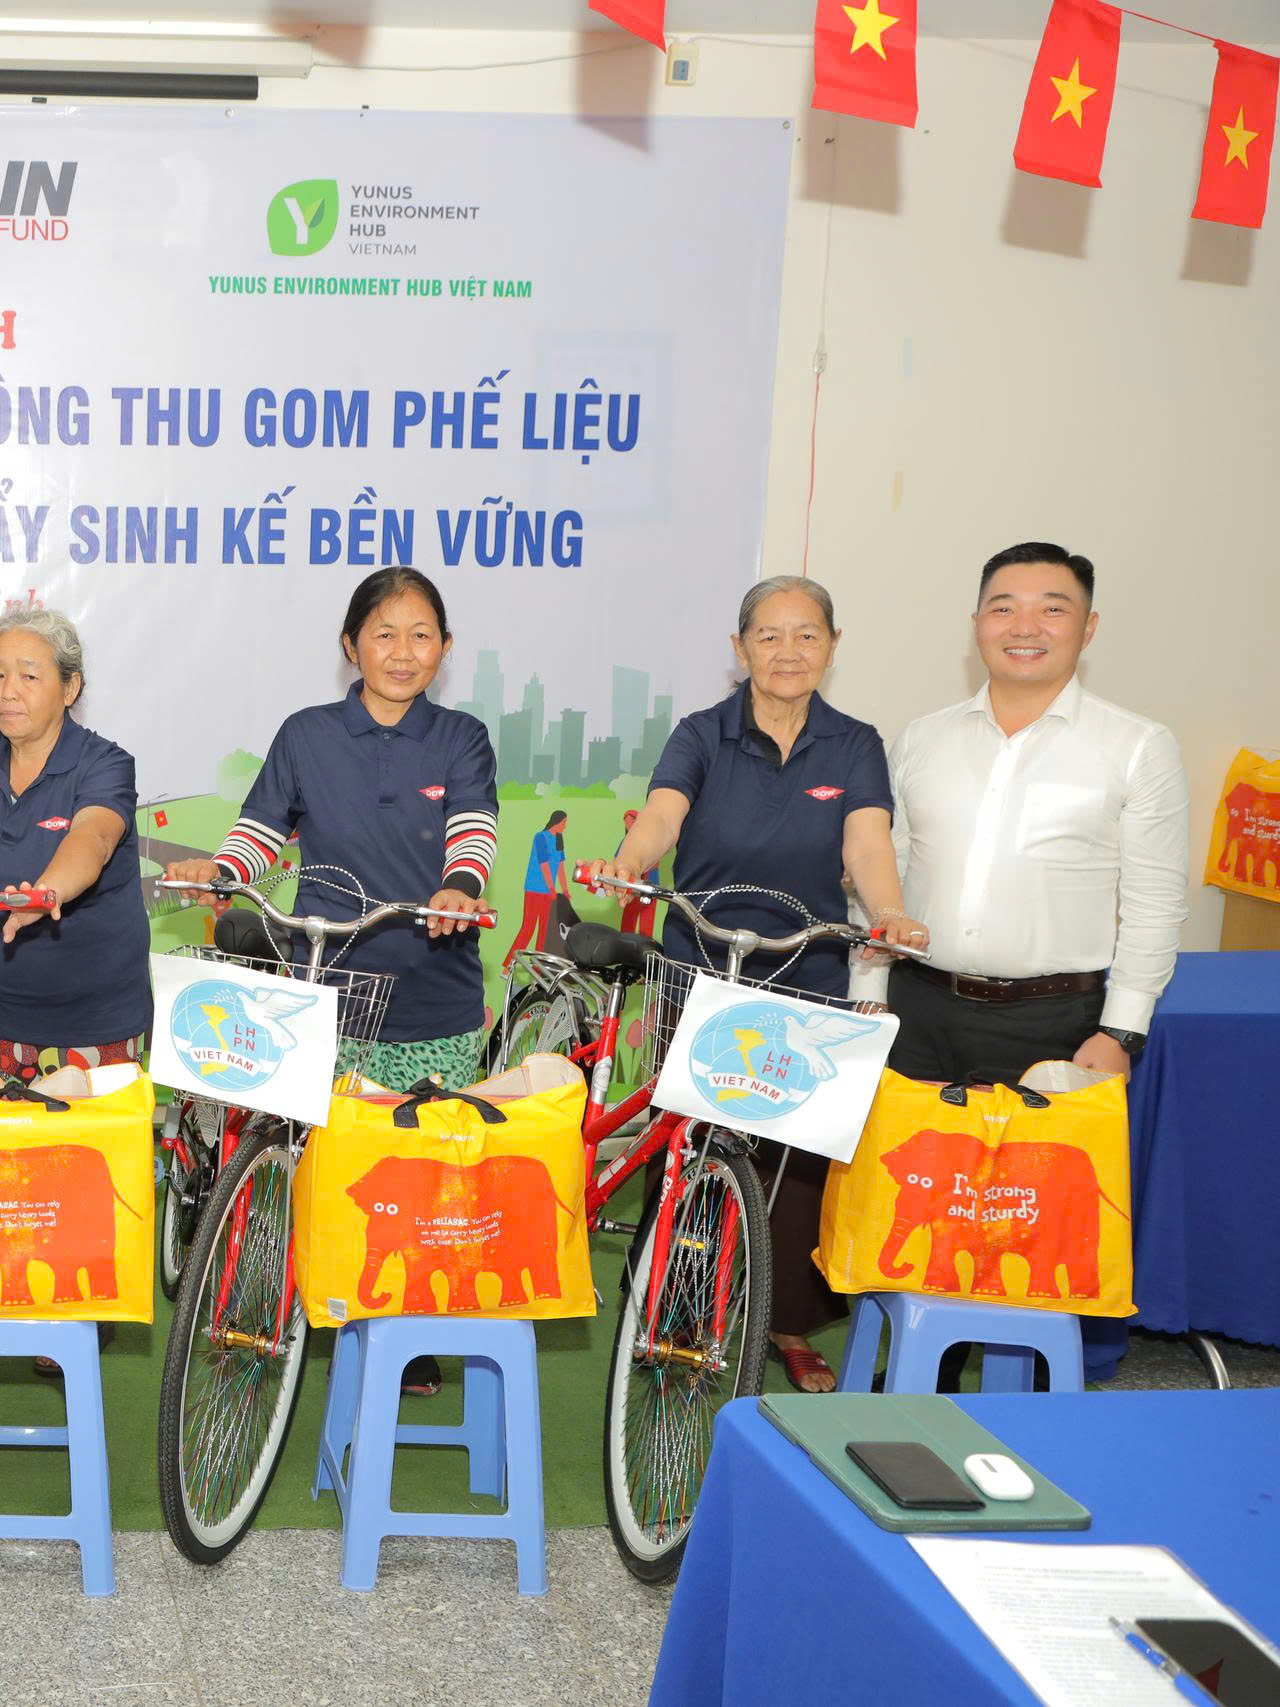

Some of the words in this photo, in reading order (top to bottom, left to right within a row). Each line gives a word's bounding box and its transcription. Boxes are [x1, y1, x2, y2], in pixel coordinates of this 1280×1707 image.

[352, 186, 412, 199] YUNUS
[351, 205, 477, 219] ENVIRONMENT
[350, 224, 385, 236] HUB
[349, 244, 416, 255] VIETNAM
[209, 276, 267, 294] YUNUS
[274, 277, 400, 295] ENVIRONMENT
[407, 280, 442, 296] HUB
[450, 277, 486, 300] VIỆT
[493, 281, 531, 297] NAM
[112, 388, 220, 447] THU
[245, 388, 369, 448] GOM
[393, 370, 509, 449] PHẾ
[523, 379, 640, 464] LIỆU
[70, 506, 198, 564] SINH
[222, 486, 296, 564] KẾ
[310, 487, 414, 565] BỀN
[437, 496, 582, 568] VỮNG
[227, 1054, 254, 1072] NAM
[751, 1080, 780, 1100] NAM
[952, 1173, 978, 1199] I'm
[984, 1185, 1037, 1204] strong
[948, 1200, 975, 1220] and
[981, 1200, 1040, 1225] sturdy
